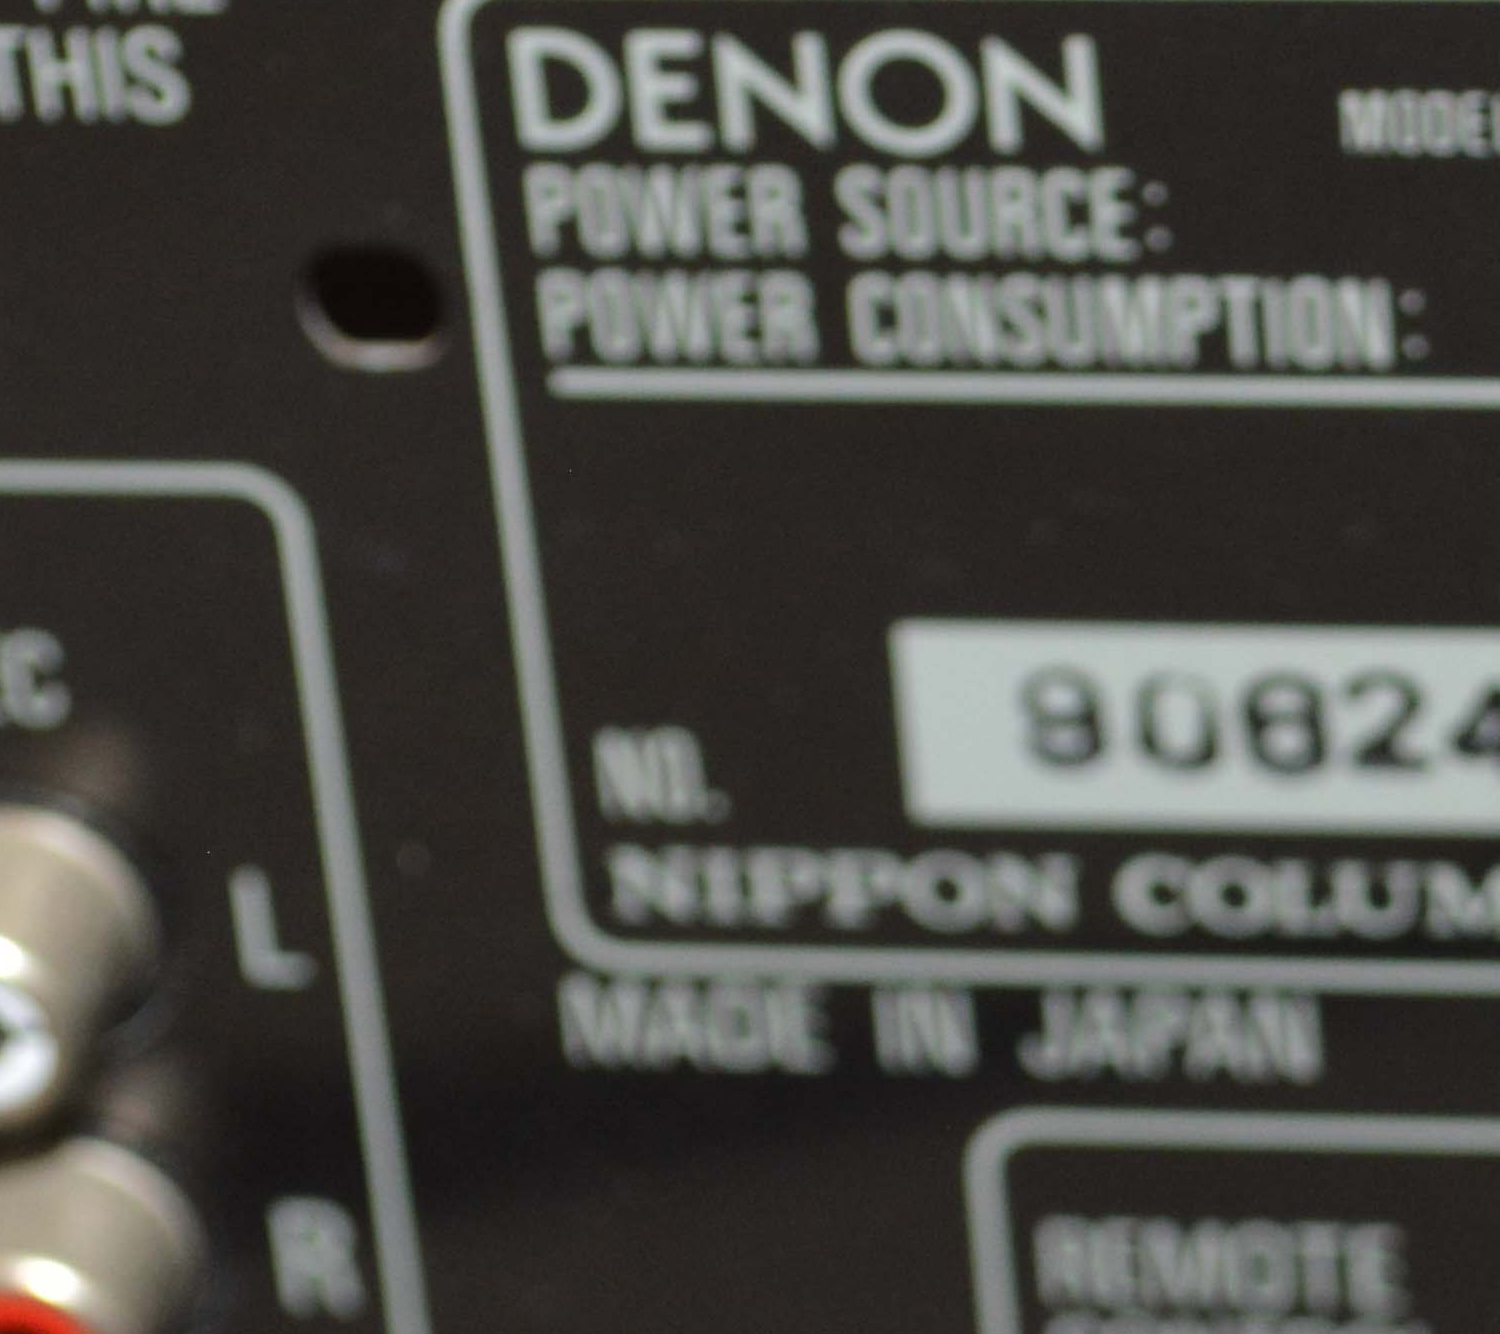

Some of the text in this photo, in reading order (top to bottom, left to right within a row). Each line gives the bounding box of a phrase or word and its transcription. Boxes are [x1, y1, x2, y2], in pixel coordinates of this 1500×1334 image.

[508, 27, 1102, 157] DENON
[524, 163, 1165, 261] POWER SOURCE:
[537, 268, 1427, 369] POWER CONSUMPTION:
[594, 728, 729, 820] NO.
[230, 870, 308, 987] L
[609, 845, 1076, 929] NIPPON
[557, 977, 1323, 1082] MADE IN JAPAN
[270, 1199, 362, 1314] R
[1035, 1217, 1398, 1311] REMOTE
